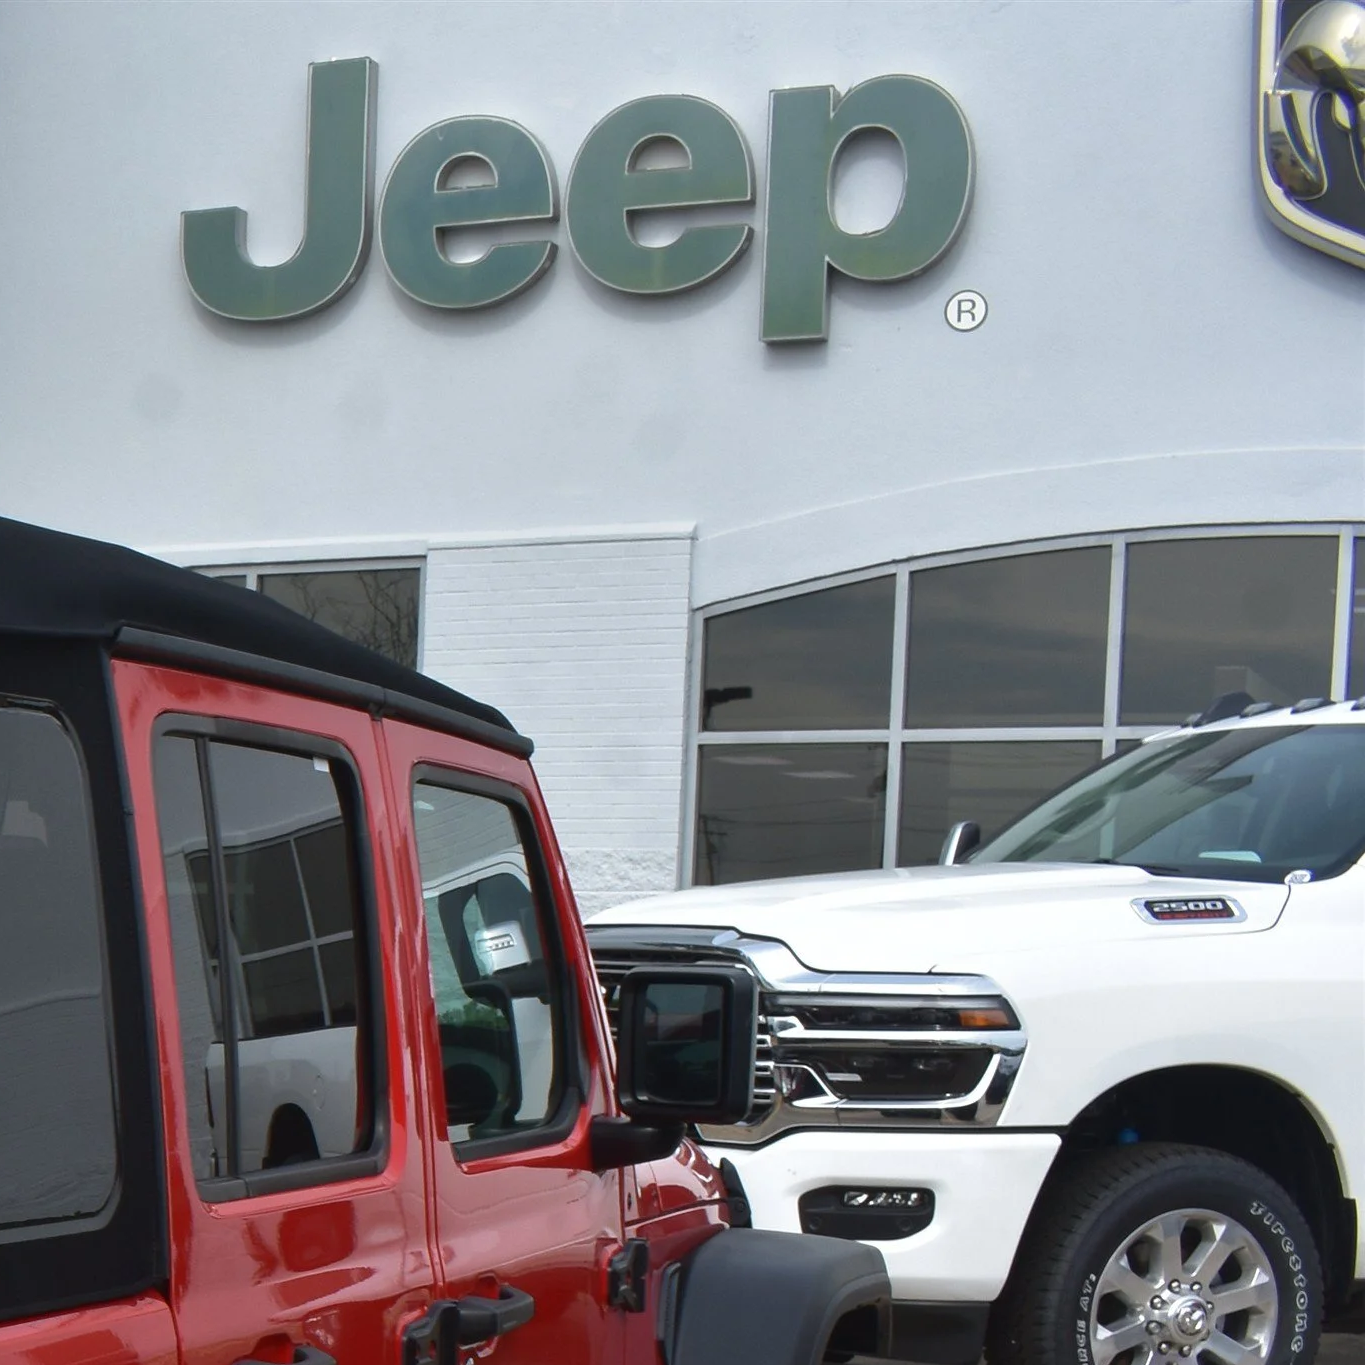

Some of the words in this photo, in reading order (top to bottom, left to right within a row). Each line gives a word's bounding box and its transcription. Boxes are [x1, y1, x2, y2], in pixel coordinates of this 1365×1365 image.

[180, 56, 976, 345] Jeep
[1152, 900, 1224, 913] 2500
[1250, 1200, 1308, 1353] Firestone
